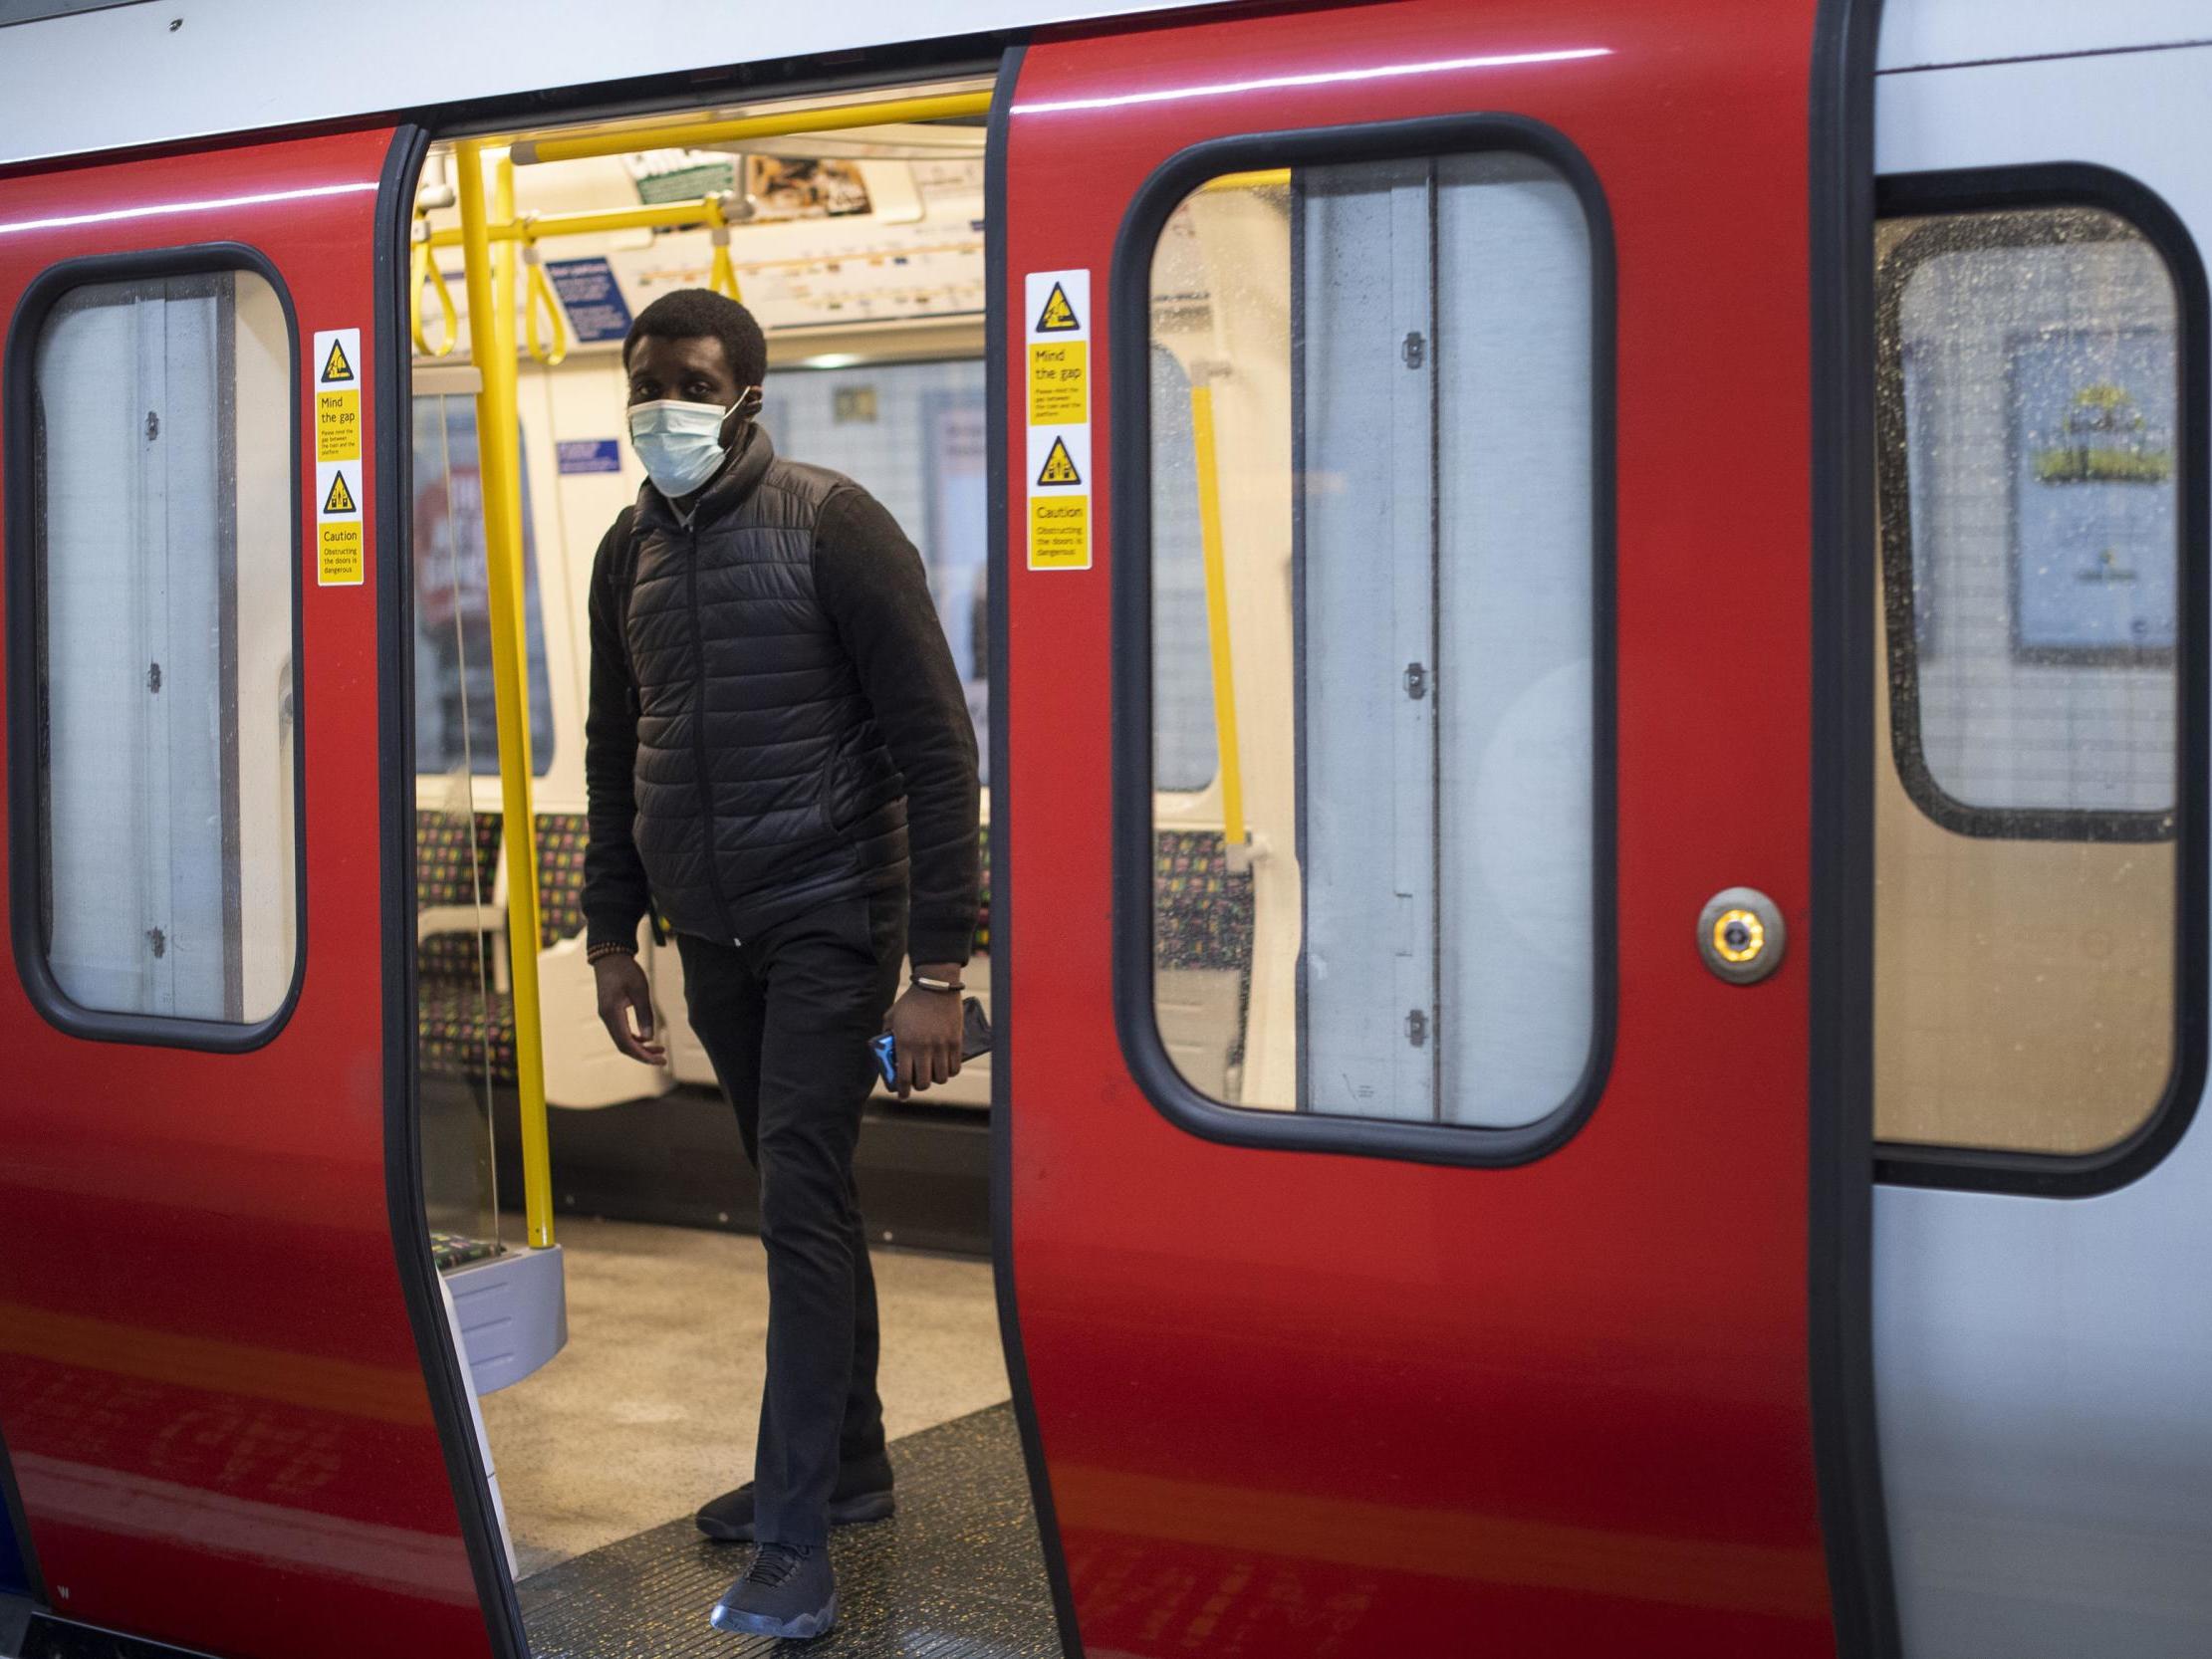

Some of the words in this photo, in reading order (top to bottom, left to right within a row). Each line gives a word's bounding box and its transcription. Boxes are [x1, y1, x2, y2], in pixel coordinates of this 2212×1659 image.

[1036, 350, 1066, 361] Mind
[322, 396, 344, 408] Mind
[321, 412, 337, 423] the
[340, 412, 356, 425] gap
[1036, 506, 1084, 519] Caution
[324, 531, 358, 542] Caution
